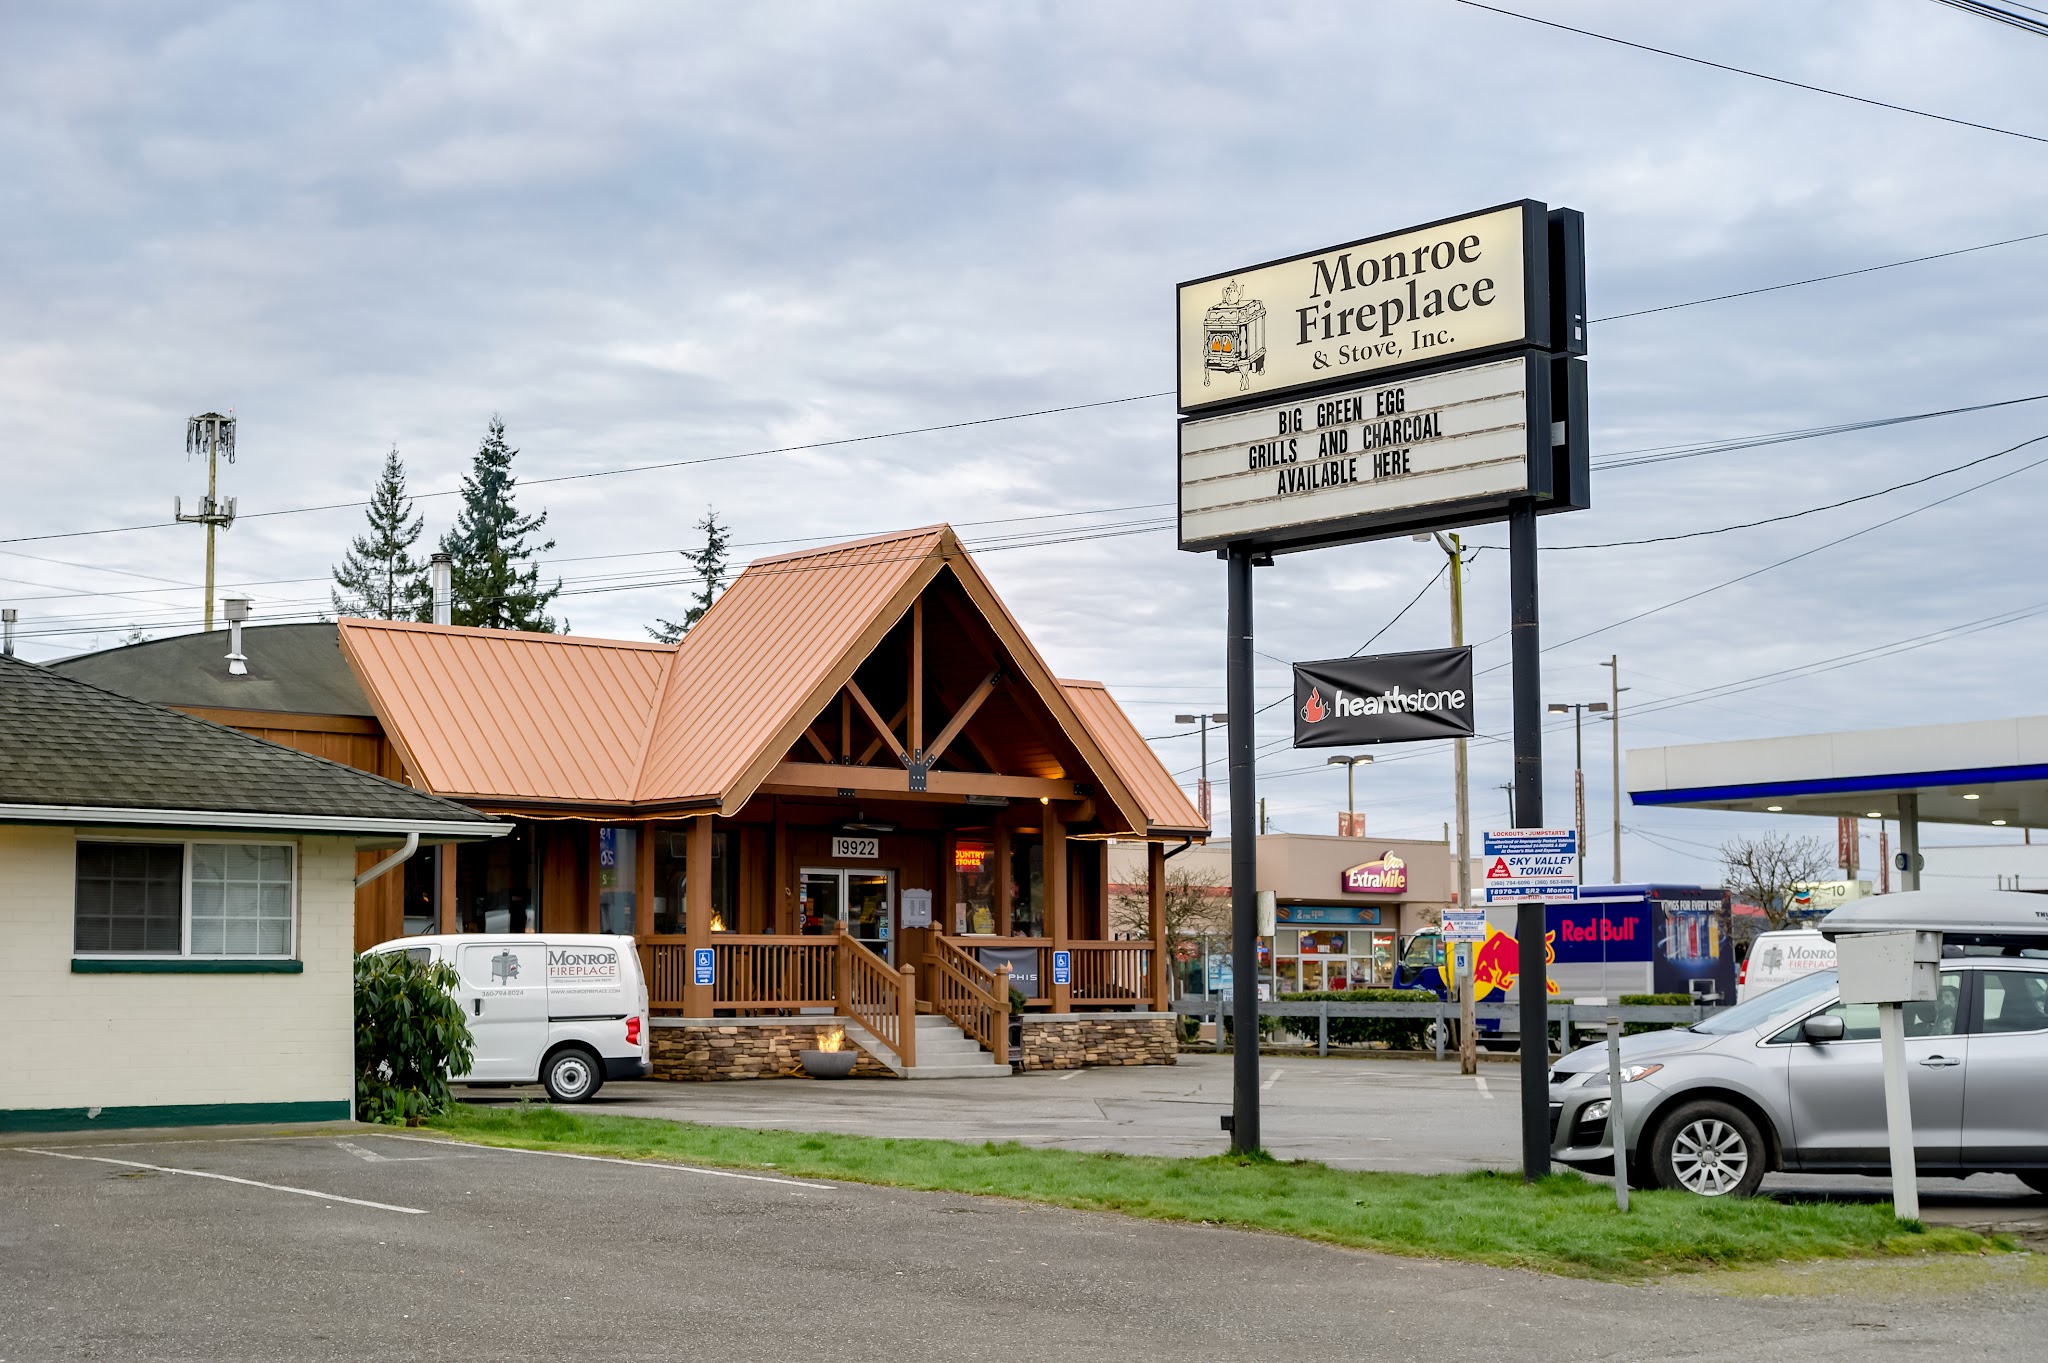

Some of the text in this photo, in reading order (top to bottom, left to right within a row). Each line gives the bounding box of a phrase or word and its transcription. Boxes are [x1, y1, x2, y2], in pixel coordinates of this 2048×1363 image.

[1309, 234, 1482, 298] Monroe
[1296, 277, 1497, 346] Fireplace
[1312, 329, 1456, 371] & Stove, Inc.
[1278, 388, 1405, 436] BIG GREEN EGG
[1248, 412, 1442, 470] GRILLS AND CHARCOAL
[1278, 449, 1411, 495] AVAILABLE HERE
[1335, 685, 1466, 718] hearthstone
[837, 840, 875, 856] 19922
[1508, 856, 1574, 866] SKY VALLEY
[1519, 867, 1563, 876] TOWING
[1348, 869, 1406, 888] ExtraMile
[1661, 900, 1680, 911] WNGS
[1680, 900, 1692, 911] FOR
[1692, 900, 1707, 911] EVERY
[1562, 919, 1597, 942] Red
[548, 950, 617, 966] MONROE
[1787, 946, 1837, 960] MONRO
[550, 966, 616, 976] FIREPLACE
